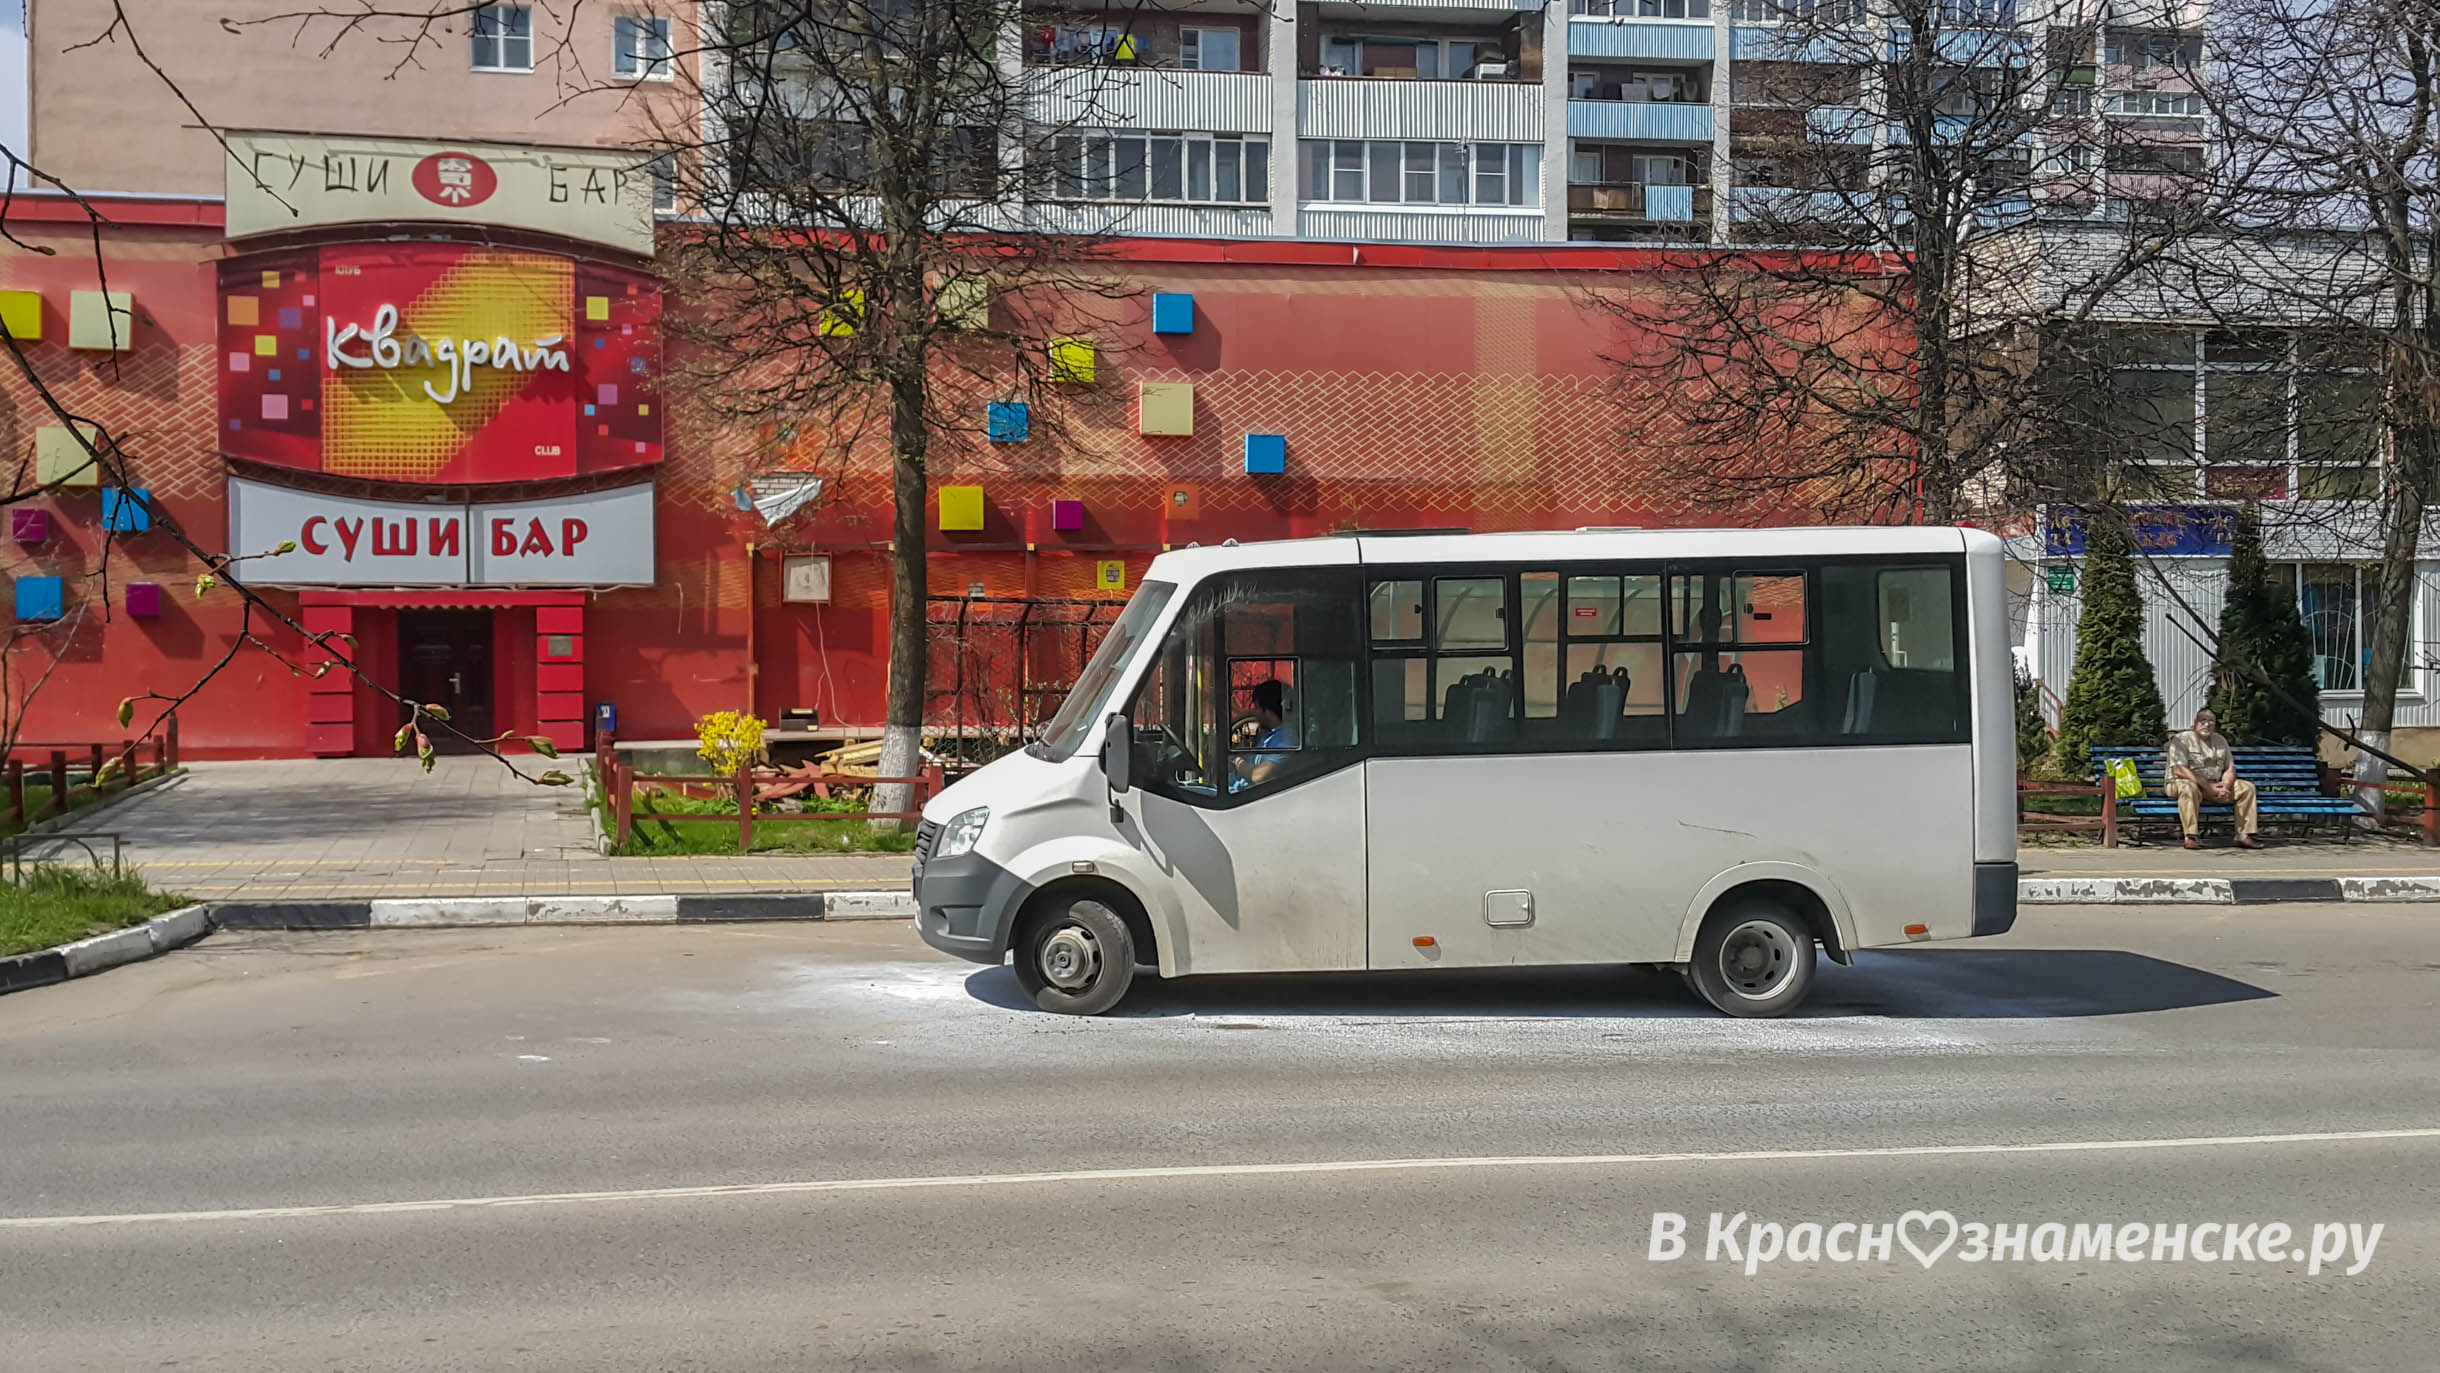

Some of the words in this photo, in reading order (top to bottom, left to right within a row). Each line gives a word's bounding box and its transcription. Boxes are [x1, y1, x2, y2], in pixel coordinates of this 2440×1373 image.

[254, 152, 390, 195] СУШИ
[549, 167, 629, 205] БАР
[534, 445, 561, 456] CLUB
[301, 516, 460, 562] СУШИ
[491, 517, 588, 557] БАР
